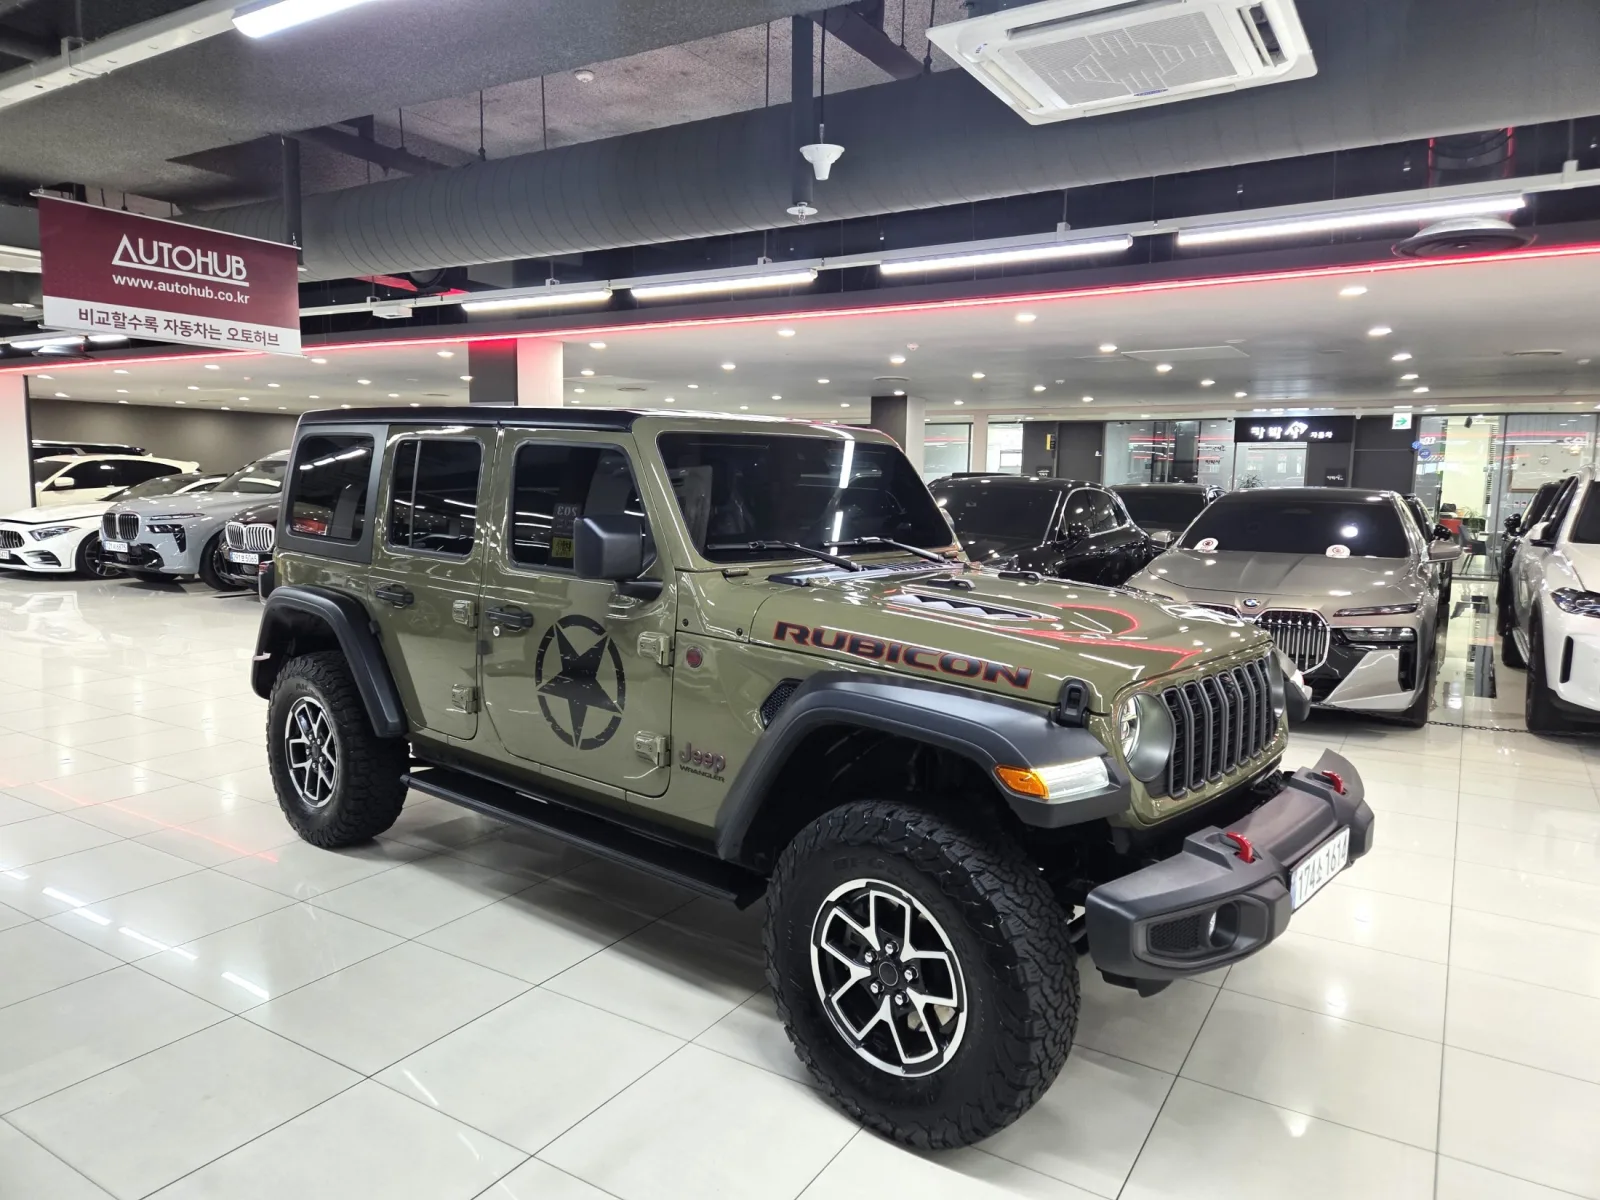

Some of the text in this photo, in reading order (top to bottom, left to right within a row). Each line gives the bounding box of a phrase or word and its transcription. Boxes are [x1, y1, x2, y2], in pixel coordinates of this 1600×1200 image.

[111, 233, 249, 286] AUTOHUB
[112, 274, 250, 304] www.autohub.co.kr
[78, 307, 280, 347] 비교할수록 자동차는 오토허브
[772, 621, 1033, 690] RUBICON
[679, 742, 726, 775] Jeep
[679, 764, 725, 783] WRANGLER
